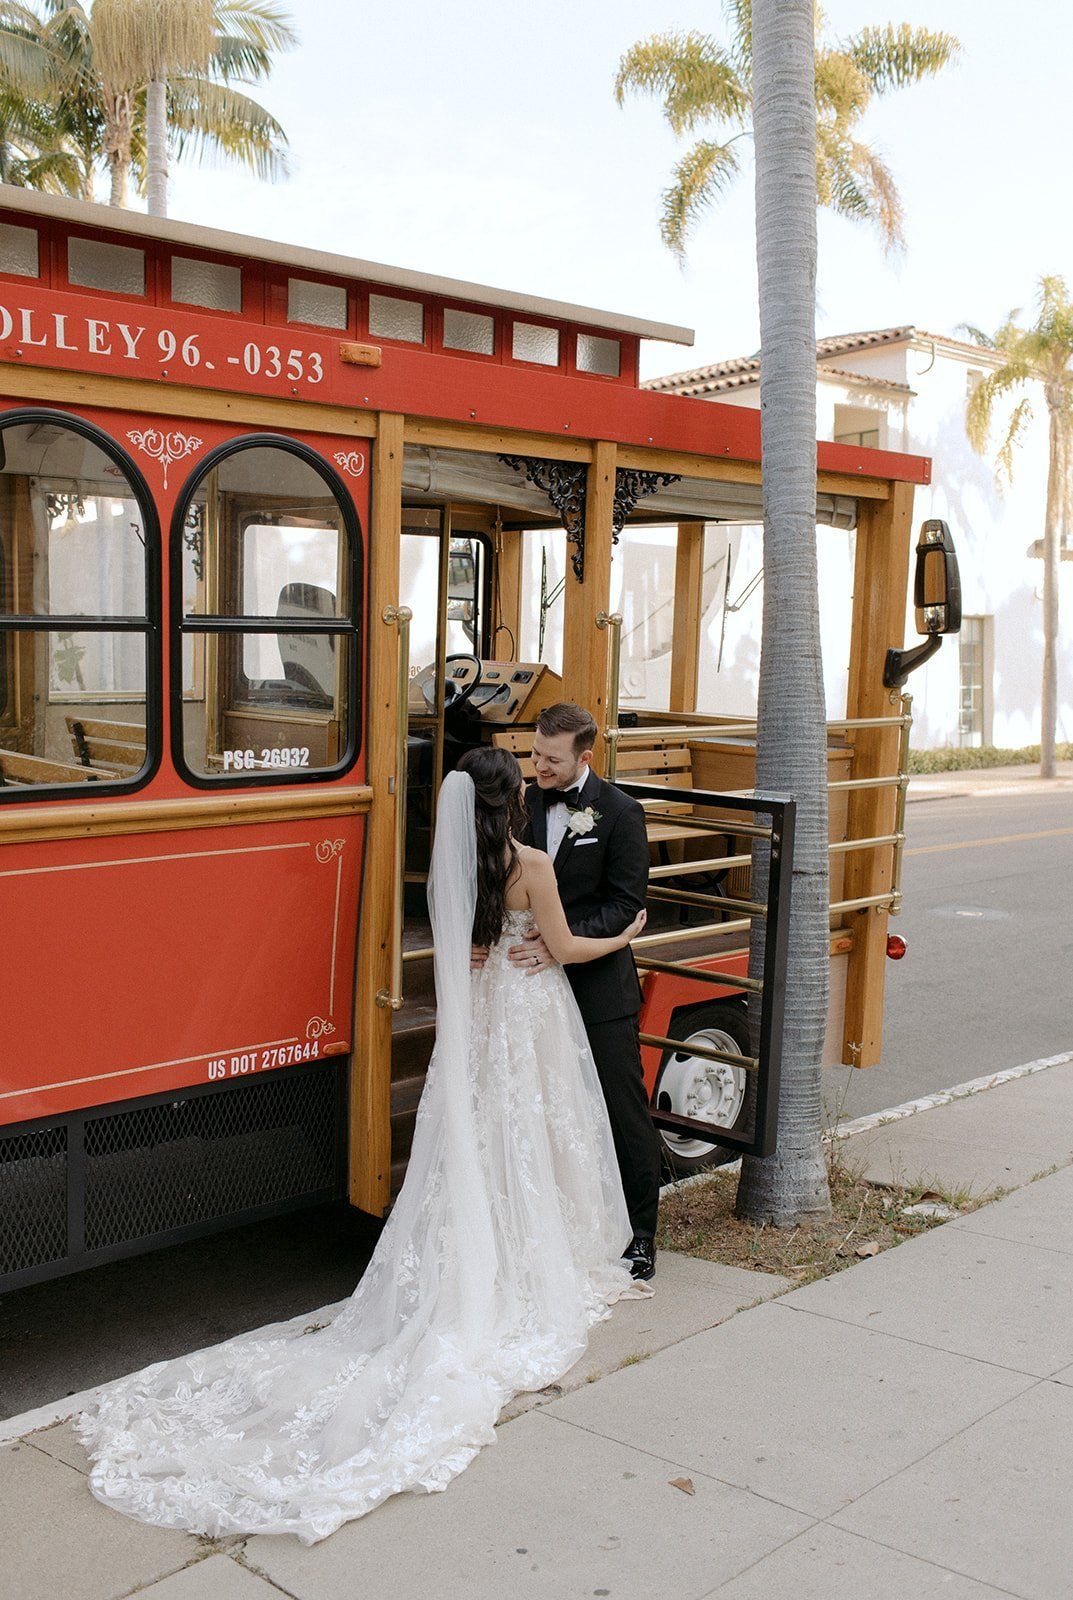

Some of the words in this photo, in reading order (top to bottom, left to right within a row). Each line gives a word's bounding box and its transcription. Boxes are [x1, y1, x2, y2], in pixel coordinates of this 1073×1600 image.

[227, 342, 324, 384] -0353
[223, 749, 255, 771] PSG
[261, 747, 310, 769] 26932
[208, 1059, 225, 1080] US
[231, 1053, 258, 1076] DOT
[261, 1040, 319, 1069] 2767644
